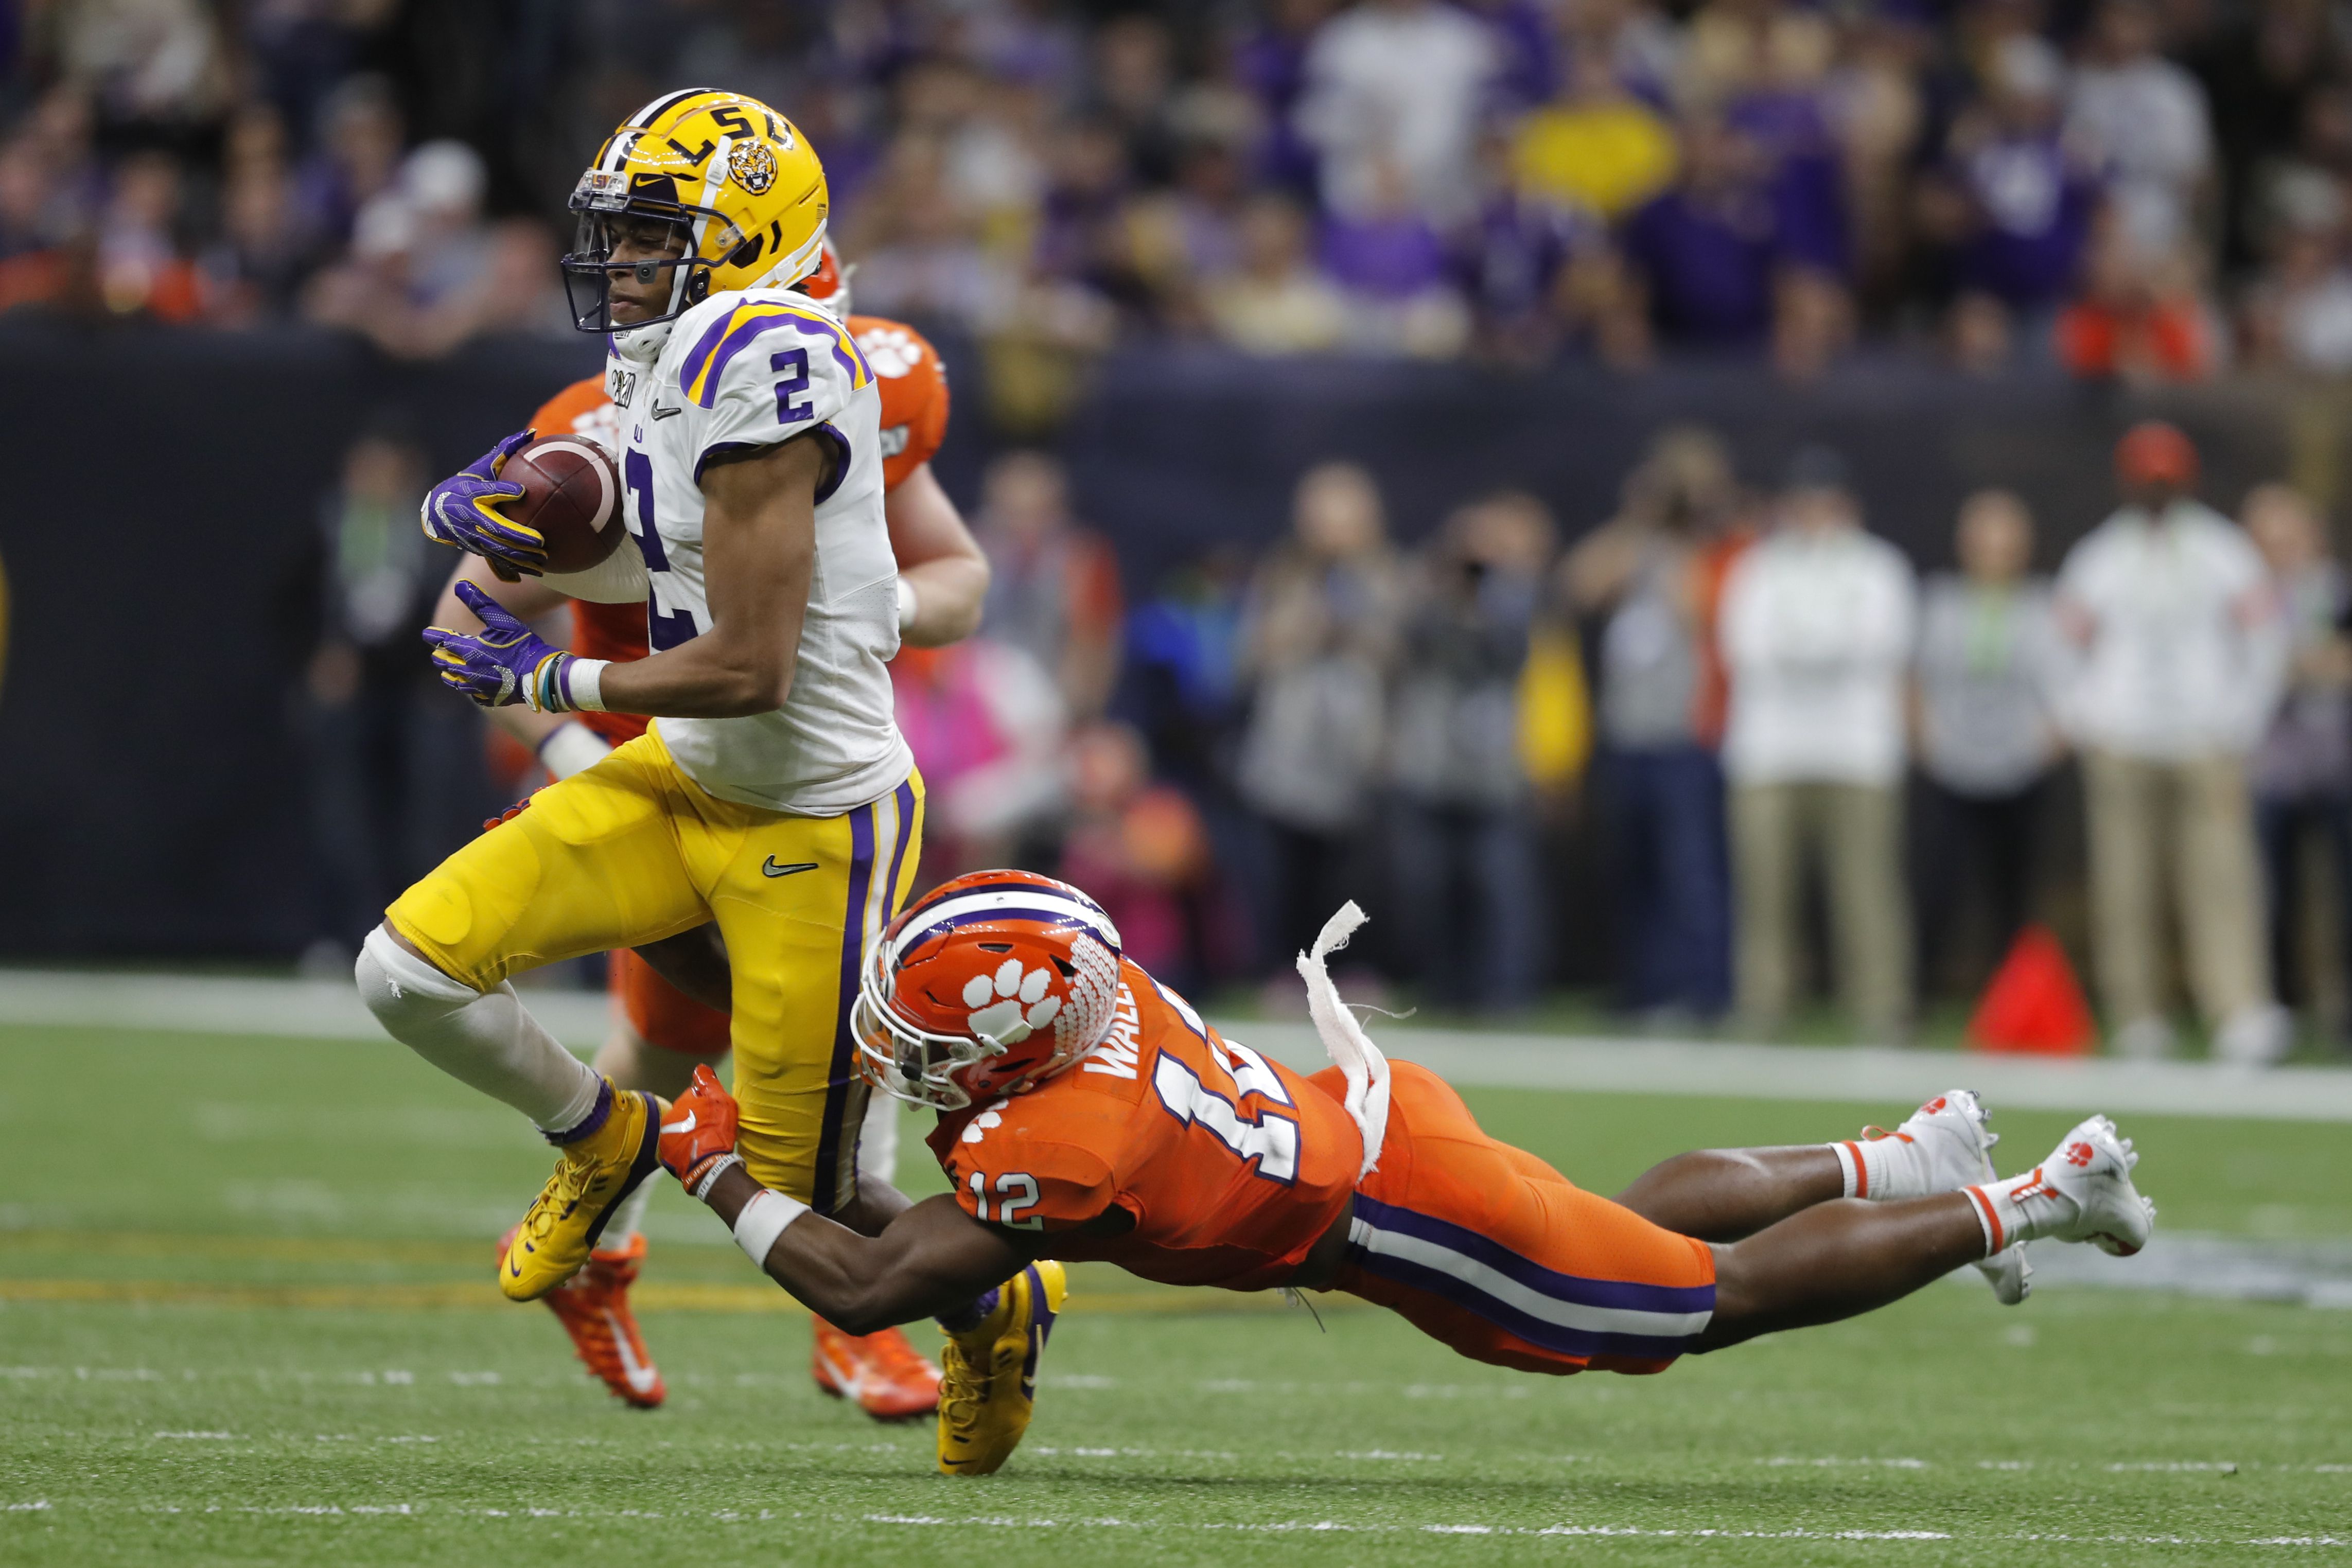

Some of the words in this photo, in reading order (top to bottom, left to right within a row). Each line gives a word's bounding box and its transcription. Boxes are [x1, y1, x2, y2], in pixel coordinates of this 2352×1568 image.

[666, 107, 794, 168] LSU
[769, 347, 814, 425] 2
[625, 446, 698, 651] 2
[1083, 982, 1139, 1080] WALL
[969, 1171, 1043, 1232] 12
